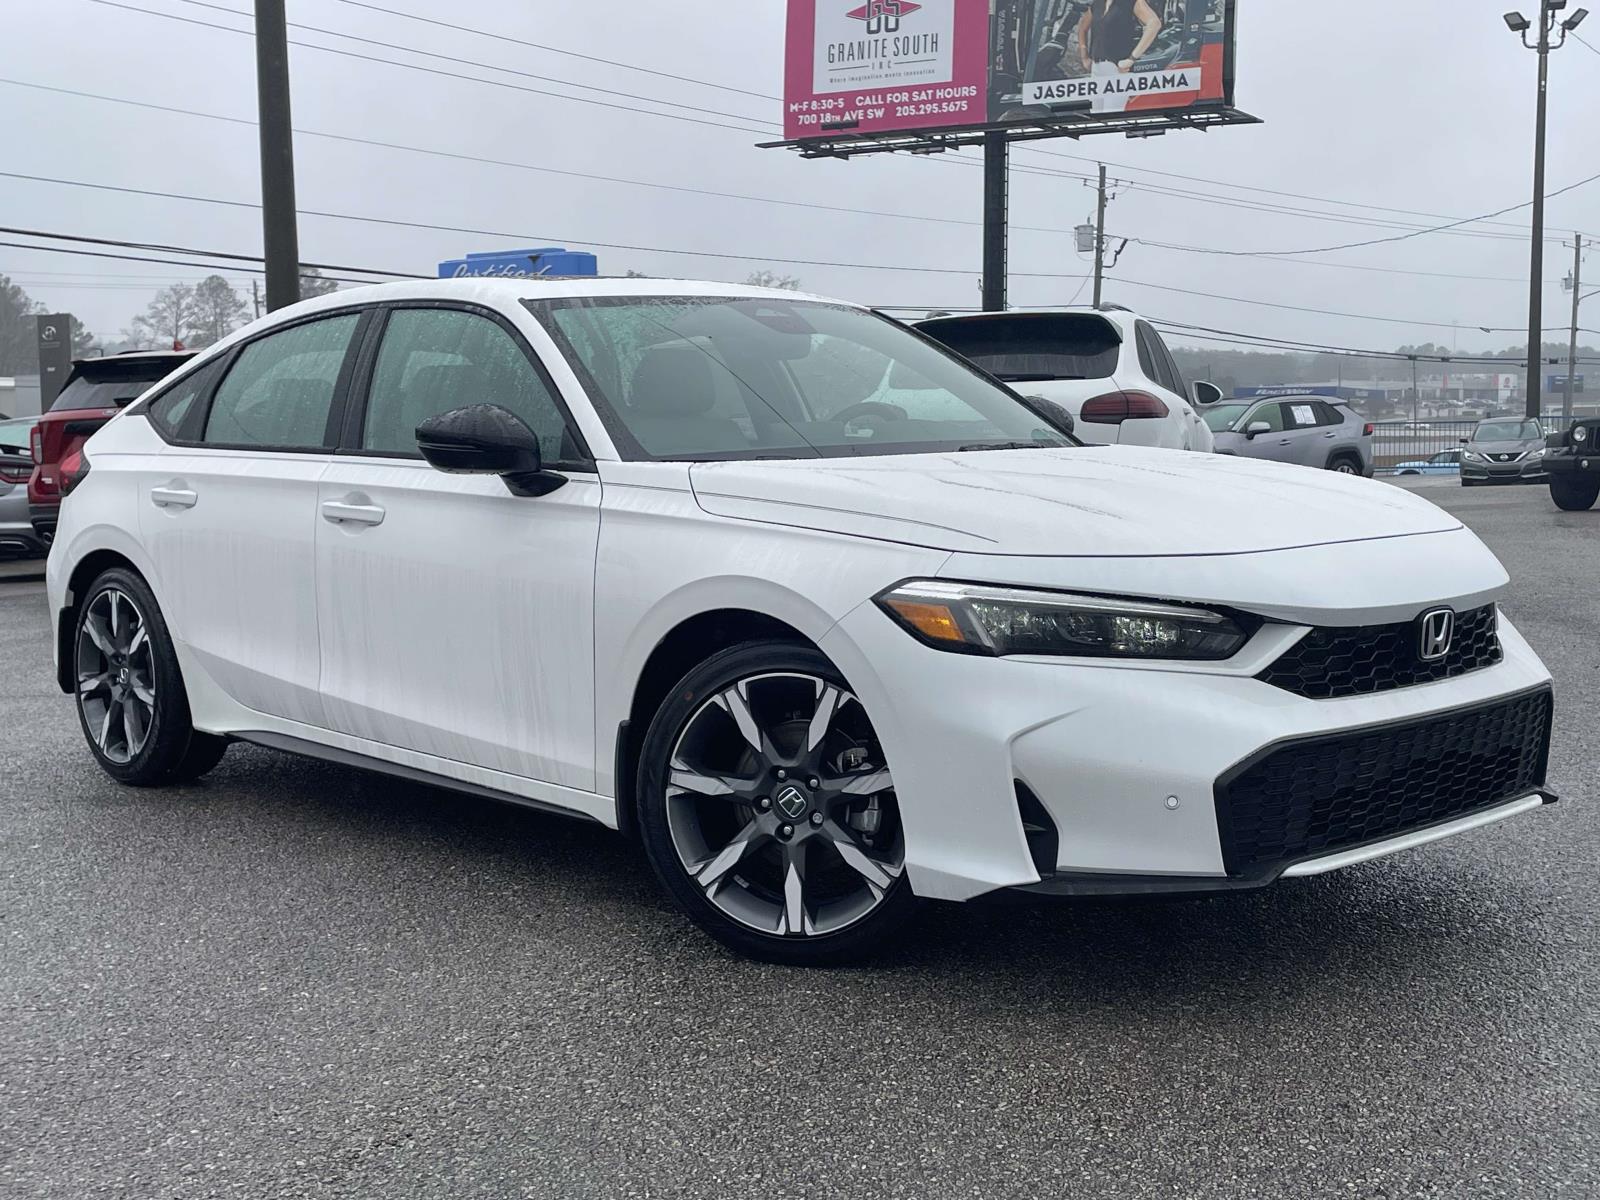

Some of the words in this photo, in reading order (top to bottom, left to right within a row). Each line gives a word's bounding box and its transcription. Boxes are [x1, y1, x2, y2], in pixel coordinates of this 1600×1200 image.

[827, 38, 888, 64] GRANITE
[893, 33, 939, 57] SOUTH
[871, 60, 892, 70] INC
[789, 101, 809, 113] M-F
[810, 98, 845, 111] 8:30-5
[855, 94, 884, 106] CALL
[886, 92, 909, 104] FOR
[911, 89, 933, 102] SAT
[935, 85, 977, 100] HOURS
[1033, 81, 1098, 100] JASPER
[1103, 73, 1189, 95] ALABAMA
[798, 114, 817, 125] 700
[819, 112, 841, 123] 18TH
[843, 109, 865, 121] AVE
[866, 107, 885, 119] SW
[895, 101, 968, 117] 205.295.5675
